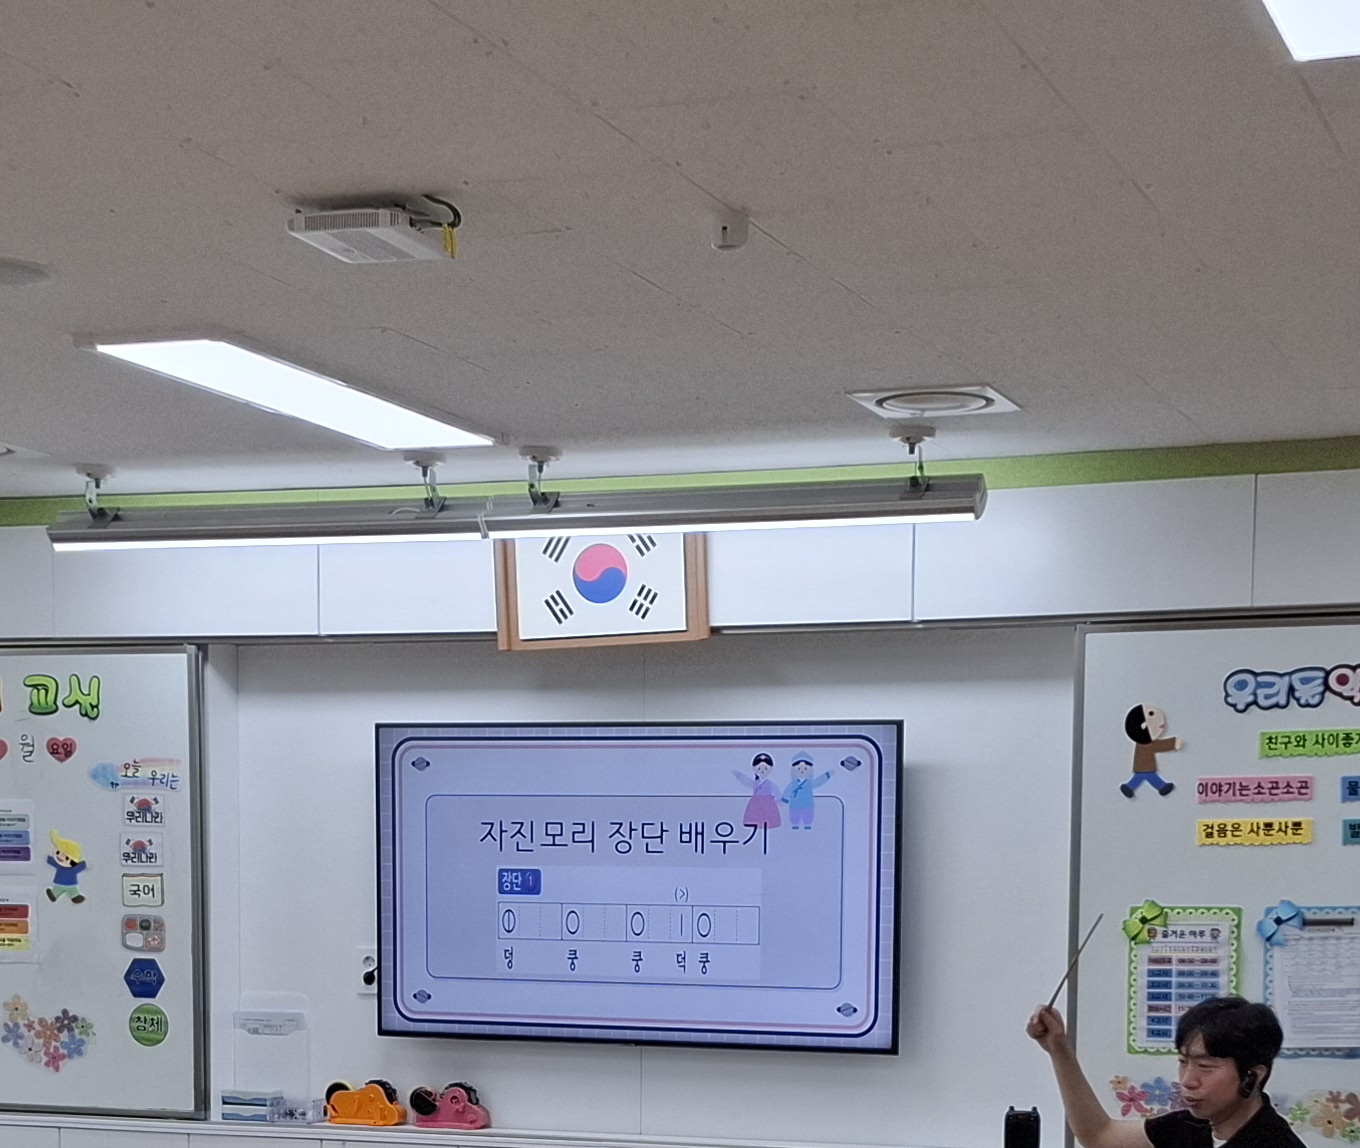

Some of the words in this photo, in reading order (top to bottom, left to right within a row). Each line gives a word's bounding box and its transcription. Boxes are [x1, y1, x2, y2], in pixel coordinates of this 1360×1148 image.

[23, 674, 100, 720] 교실
[19, 734, 35, 763] 월
[50, 742, 73, 758] 요일
[1265, 734, 1307, 750] 친구와
[121, 759, 141, 778] 오늘
[148, 770, 180, 790] 우리는
[1196, 780, 1310, 797] 이야기는소곤소곤
[126, 810, 163, 824] 우리나라
[479, 819, 595, 853] 자진모리
[608, 820, 669, 854] 장단
[679, 821, 768, 855] 배우기
[1202, 822, 1243, 838] 걸음은
[1247, 821, 1303, 837] 사뿐사뿐
[122, 851, 157, 864] 우리나라
[128, 883, 156, 898] 국어
[501, 872, 522, 891] 장단
[503, 946, 514, 970] 덩
[566, 949, 579, 972] 쿵
[630, 951, 643, 973] 쿵
[676, 950, 686, 974] 덕
[698, 952, 710, 975] 쿵
[134, 1015, 163, 1033] 창체
